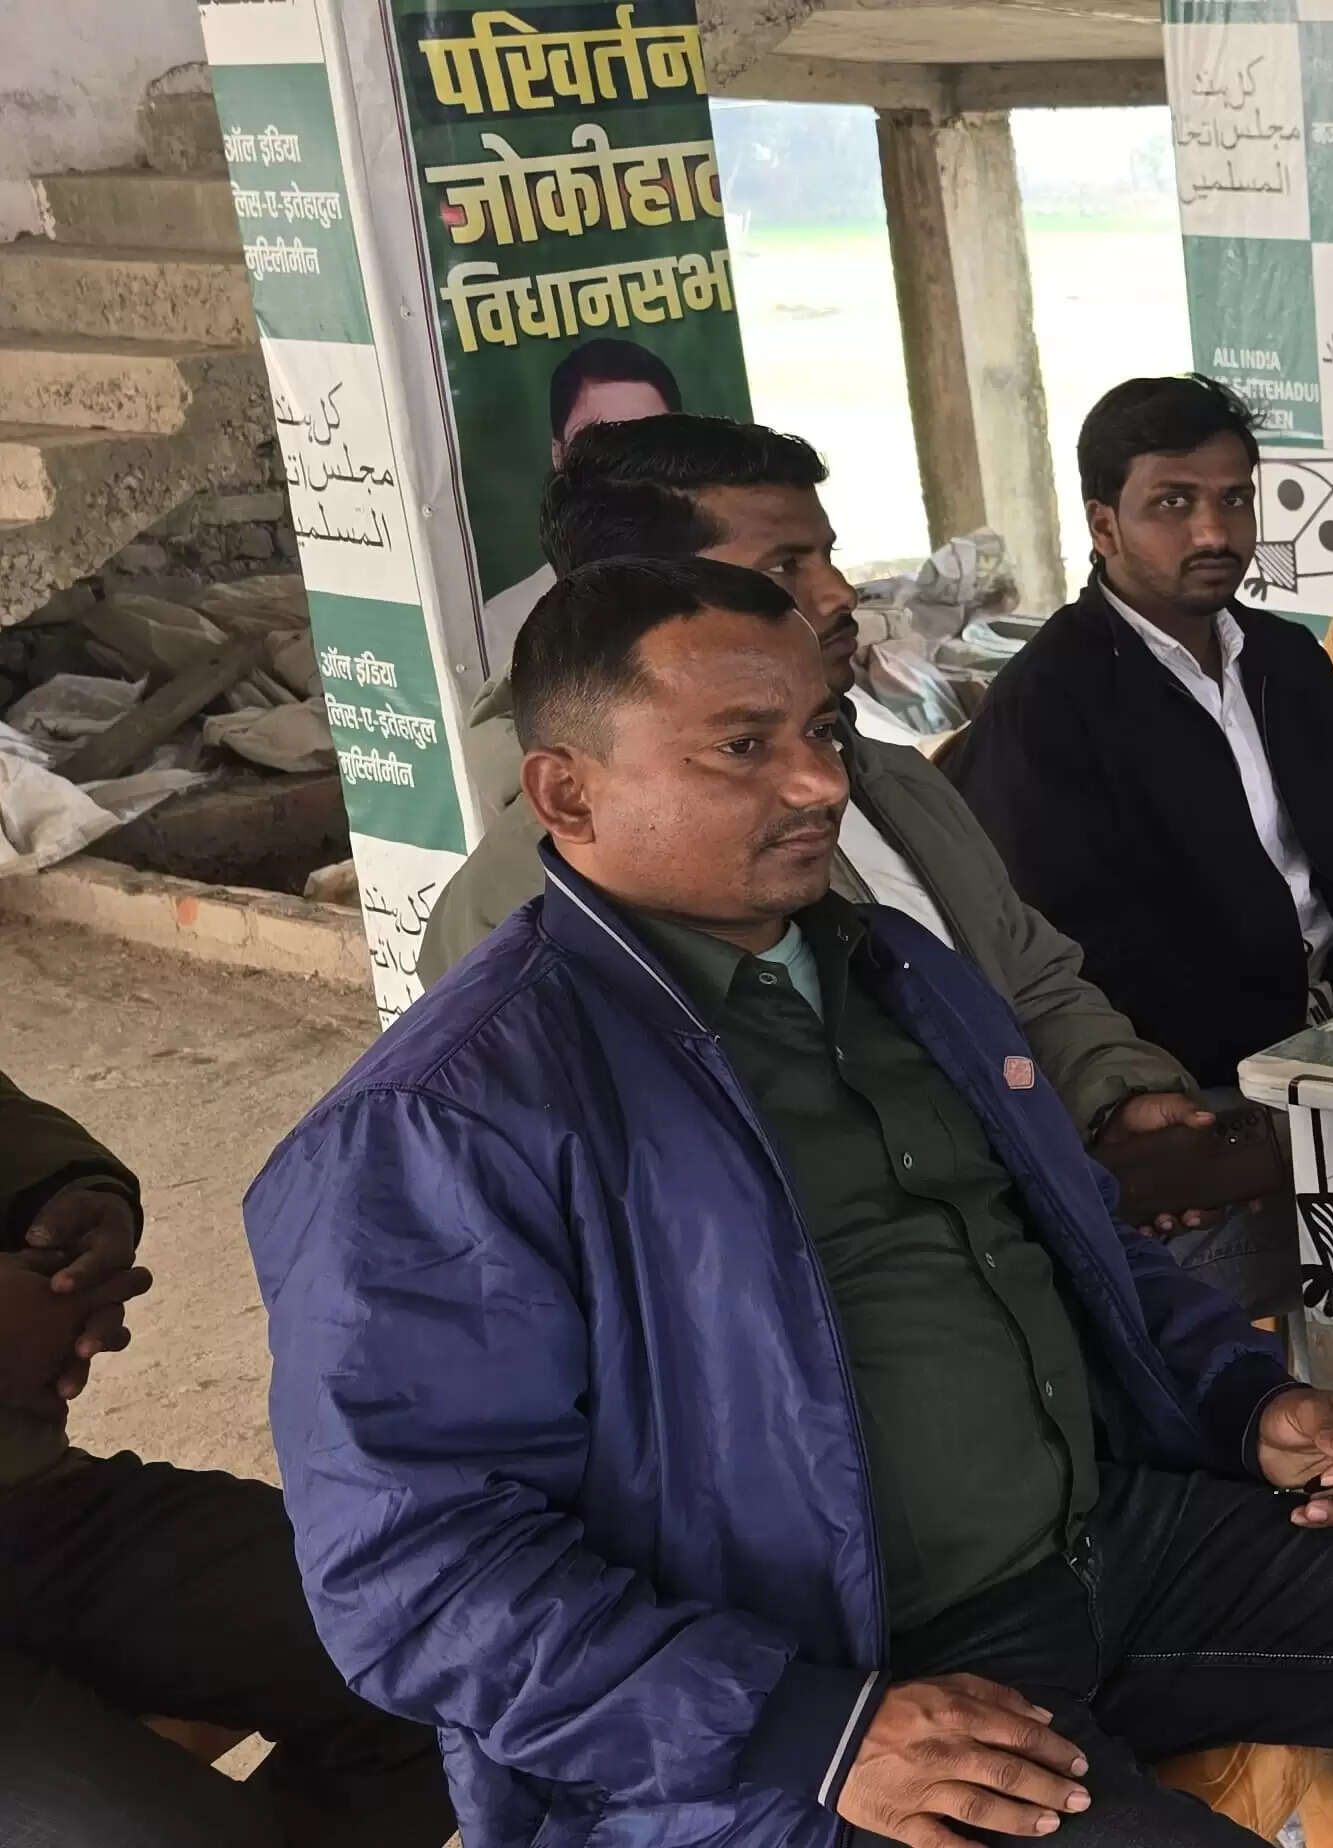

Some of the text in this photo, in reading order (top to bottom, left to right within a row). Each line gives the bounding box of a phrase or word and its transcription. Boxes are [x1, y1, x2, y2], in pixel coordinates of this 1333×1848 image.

[418, 4, 709, 114] परिवर्तन
[440, 250, 736, 352] विधानसभ
[1213, 347, 1281, 372] ALL INDIA
[308, 443, 394, 494] مجلس
[320, 646, 397, 688] ऑल इंडिया
